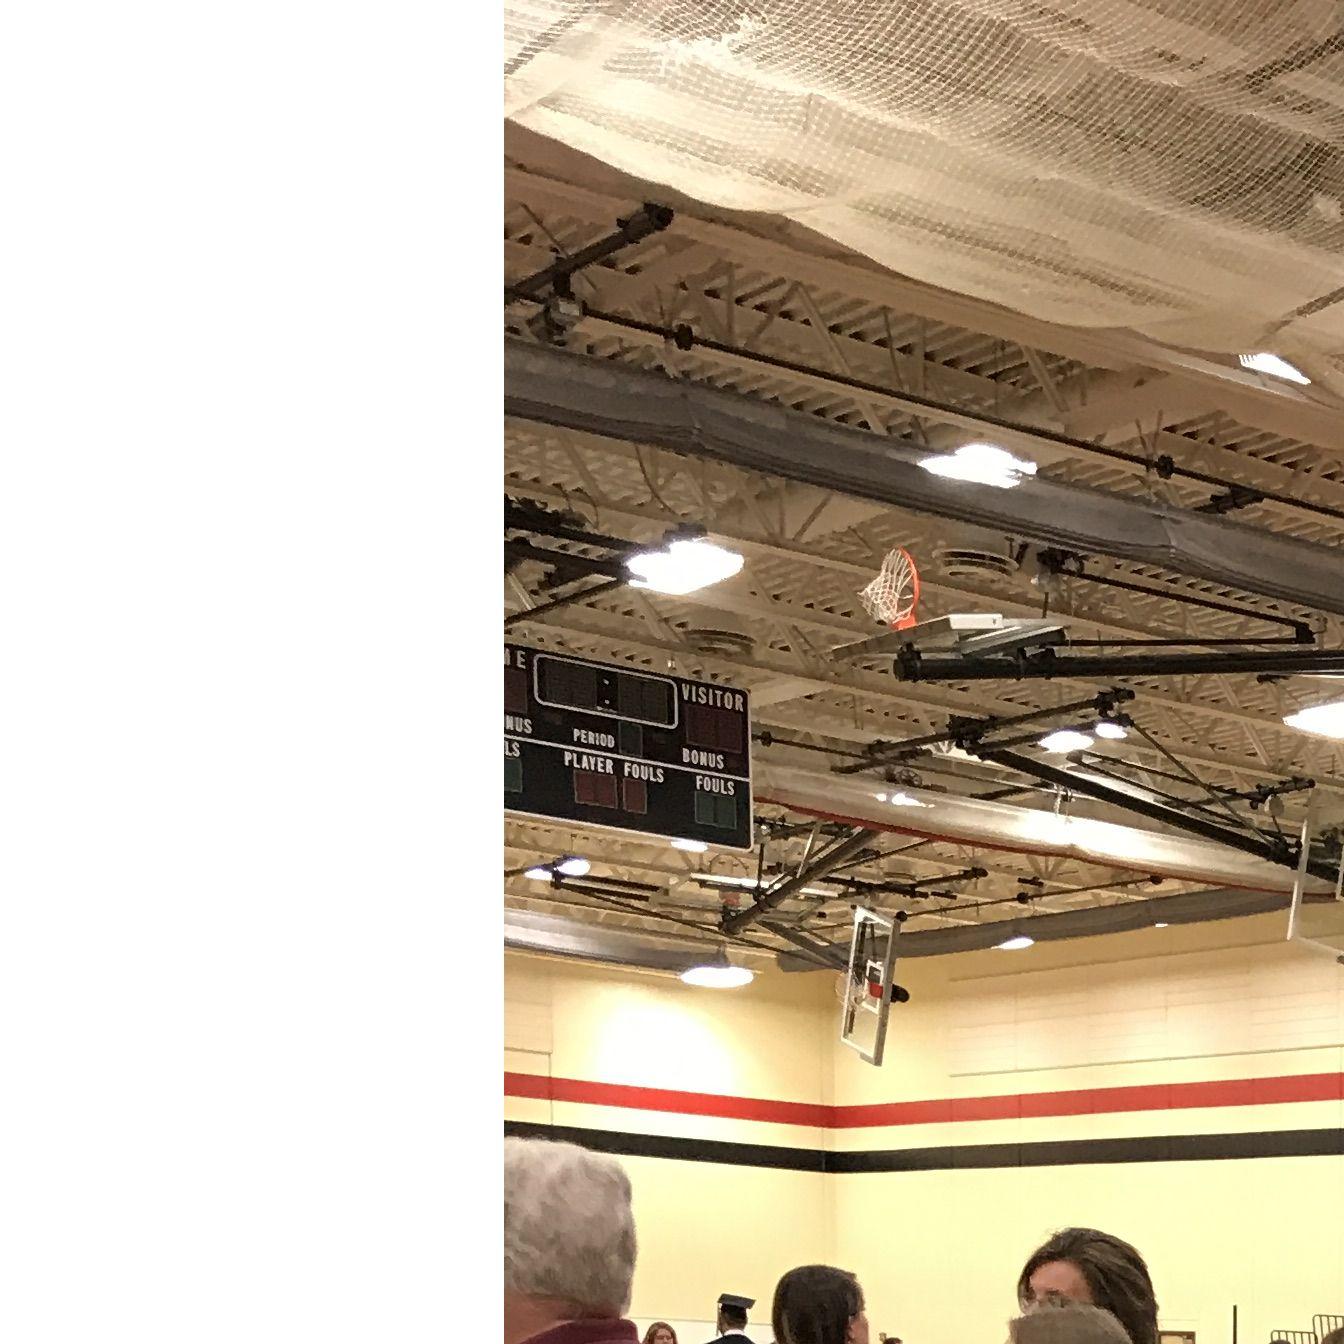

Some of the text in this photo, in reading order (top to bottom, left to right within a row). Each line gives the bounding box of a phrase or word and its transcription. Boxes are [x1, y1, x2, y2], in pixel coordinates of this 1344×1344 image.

[682, 684, 744, 712] VISITOR
[573, 729, 615, 748] PERIOD
[564, 752, 664, 783] PLAYER FOULS
[683, 748, 724, 769] BONUS
[696, 776, 735, 795] FOULS
